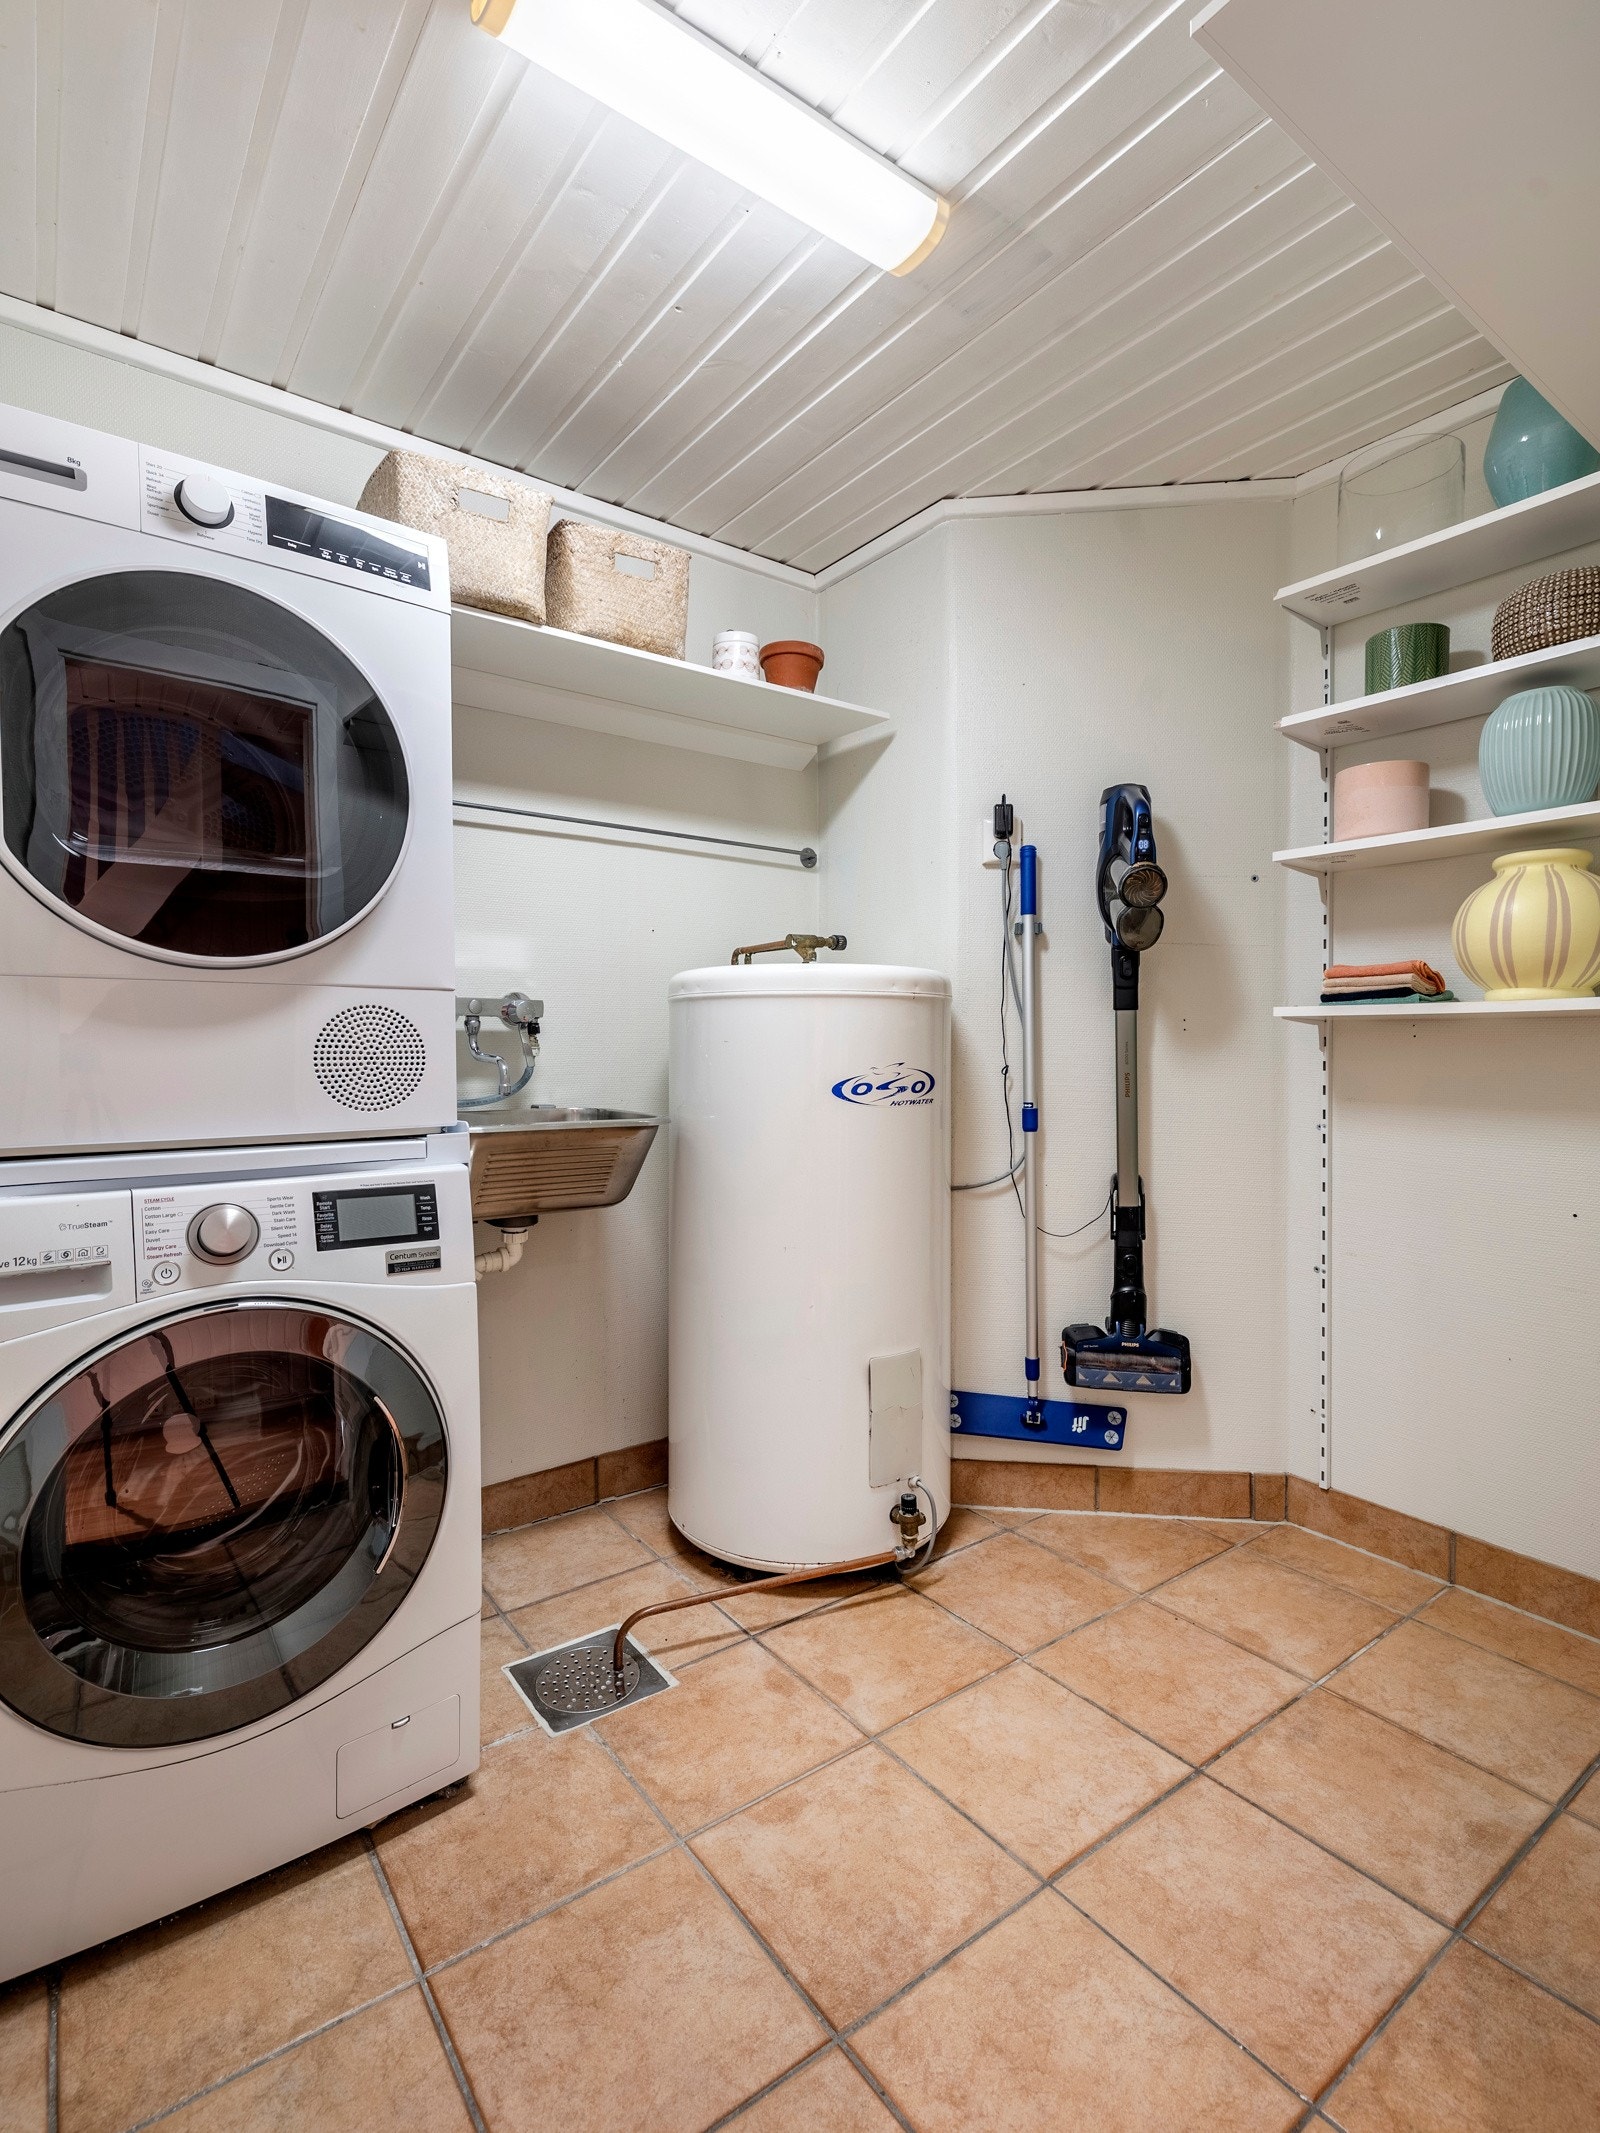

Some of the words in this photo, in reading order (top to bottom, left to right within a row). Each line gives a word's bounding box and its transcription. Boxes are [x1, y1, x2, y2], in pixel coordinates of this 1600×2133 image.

[890, 1098, 934, 1107] HOTWATER
[67, 1221, 108, 1230] TrueSteam
[390, 1252, 417, 1261] Centum
